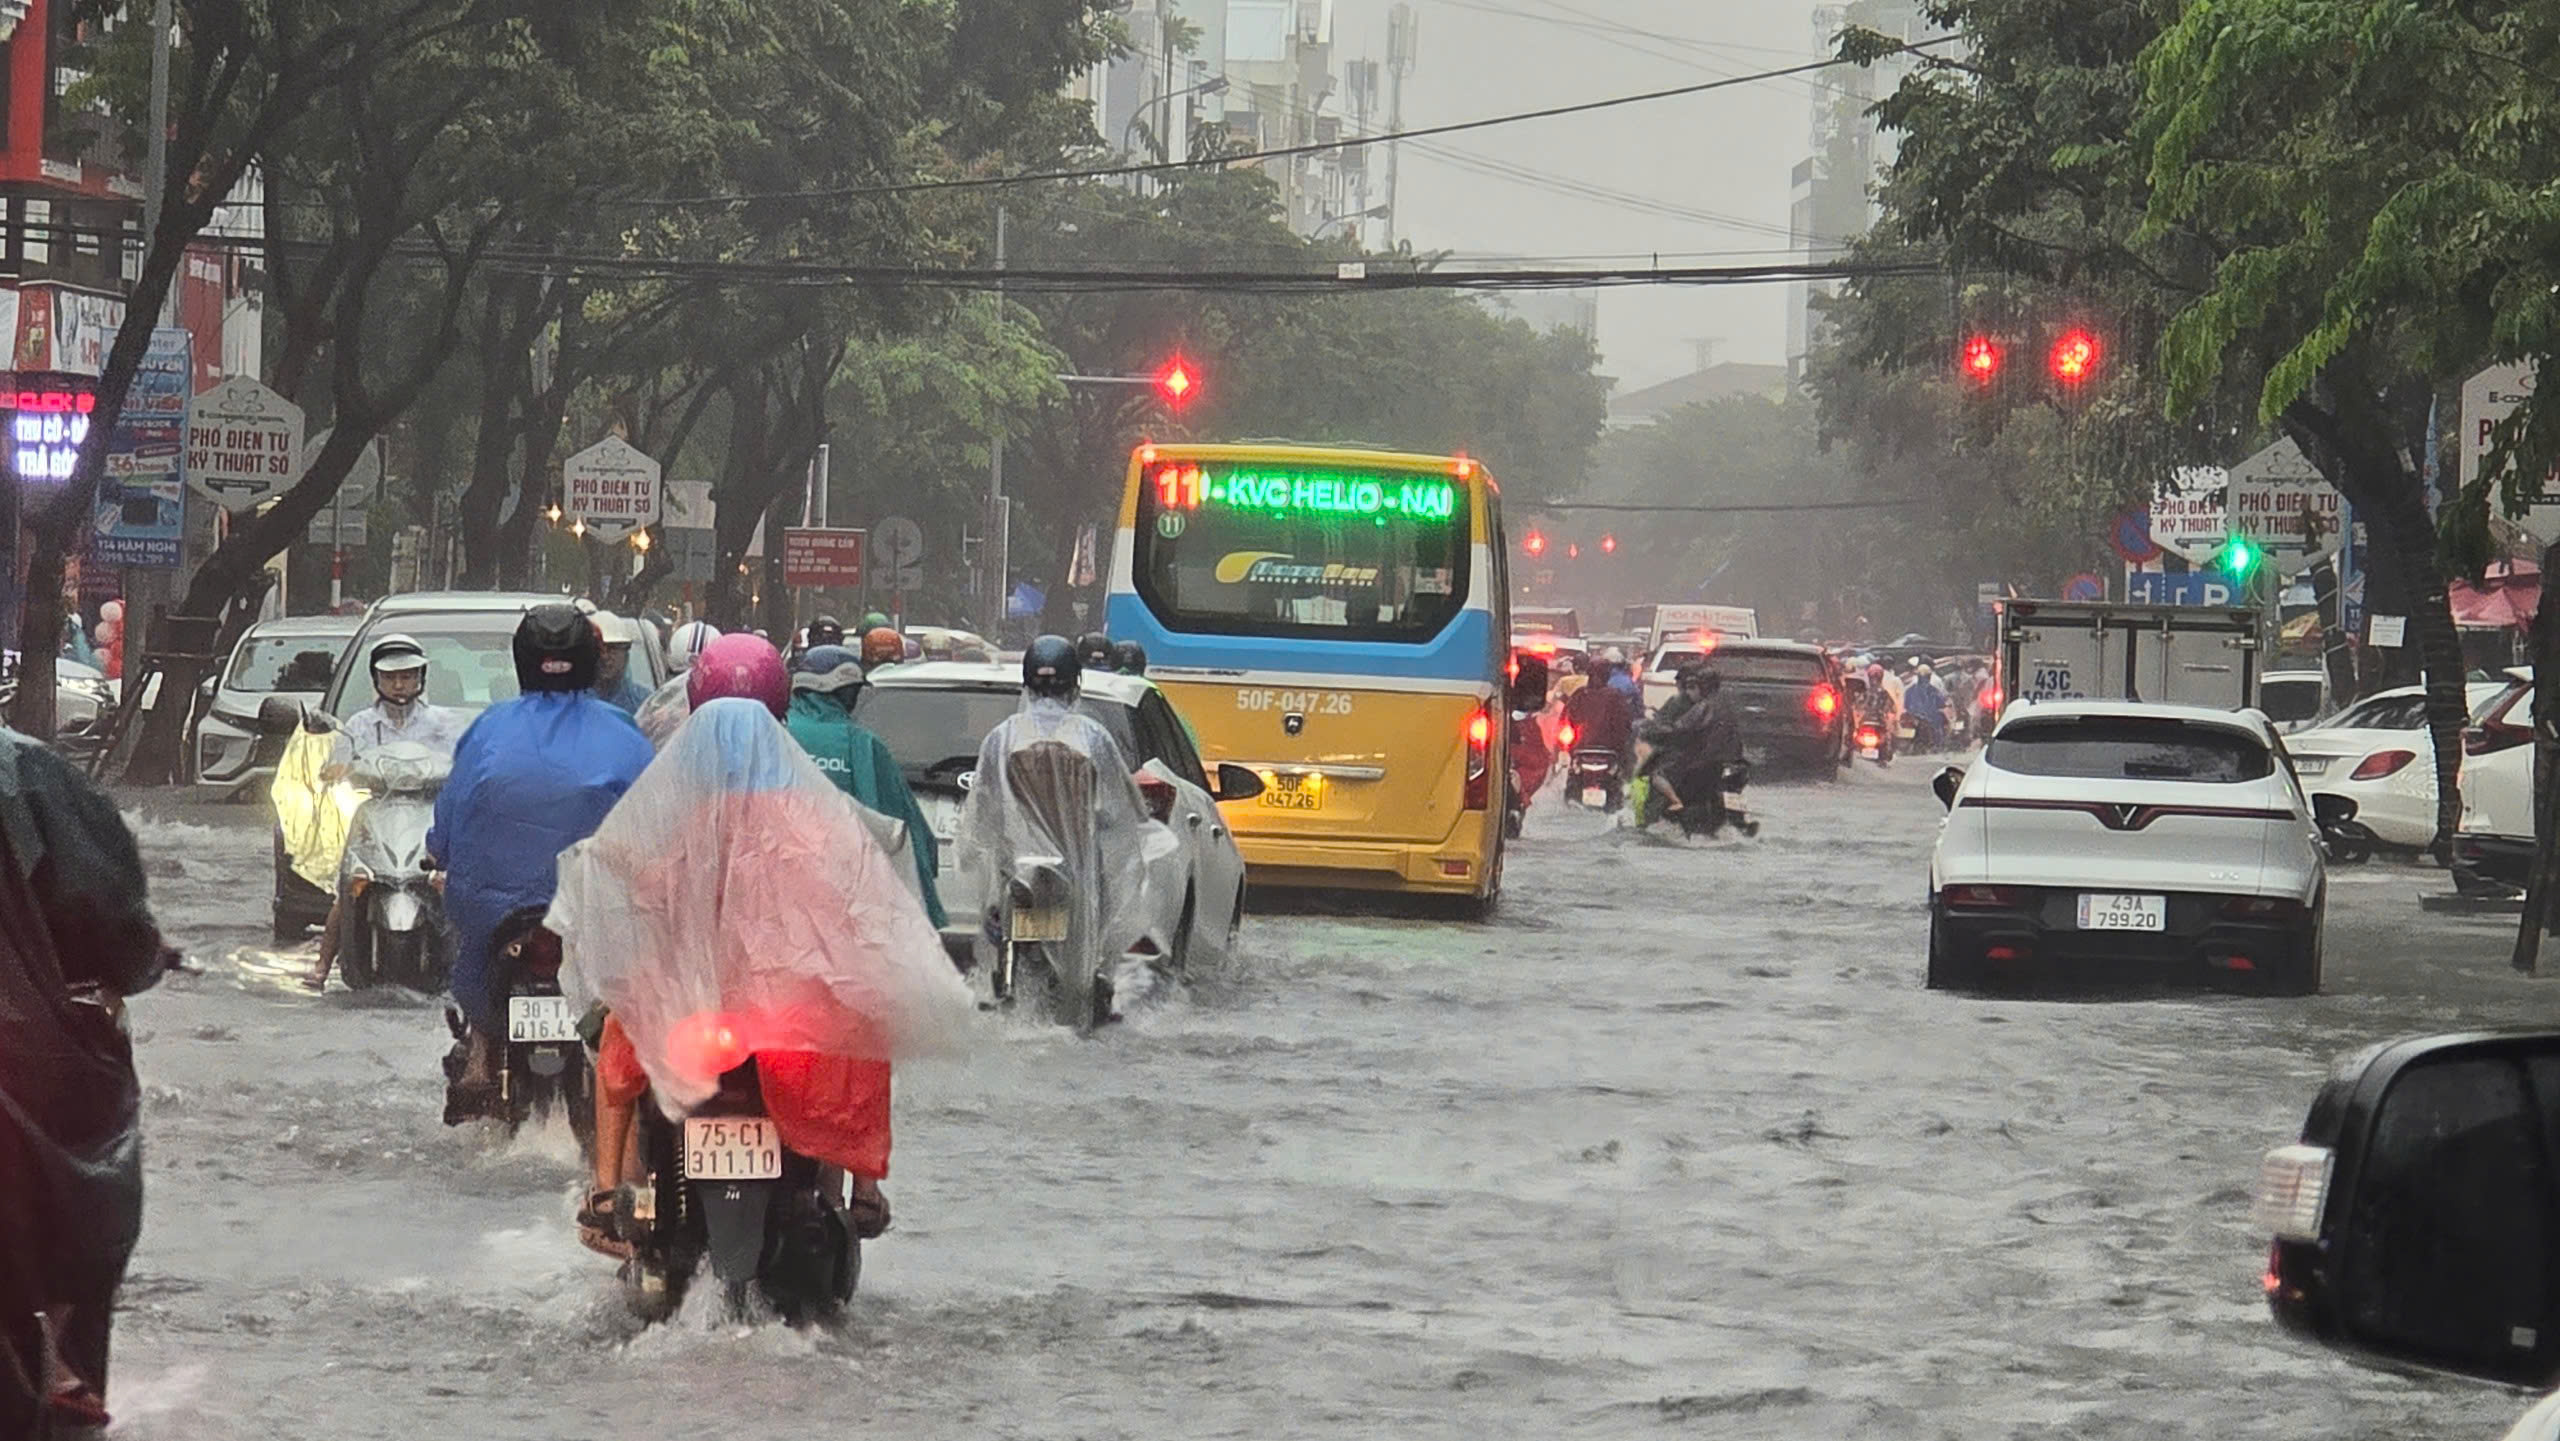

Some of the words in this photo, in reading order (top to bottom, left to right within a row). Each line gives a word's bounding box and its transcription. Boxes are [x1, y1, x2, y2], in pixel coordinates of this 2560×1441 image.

[189, 423, 222, 448] PHỐ
[1160, 469, 1199, 506] 11
[2239, 488, 2270, 513] PHỐ
[2034, 670, 2071, 690] 43C
[1237, 689, 1353, 716] 50F-047.26
[1277, 776, 1303, 792] 50F
[1266, 792, 1314, 808] 047.26
[2112, 895, 2143, 911] 43A
[2097, 912, 2157, 928] 799.20
[700, 1122, 762, 1147] 75-C1
[692, 1149, 774, 1175] 311.10
